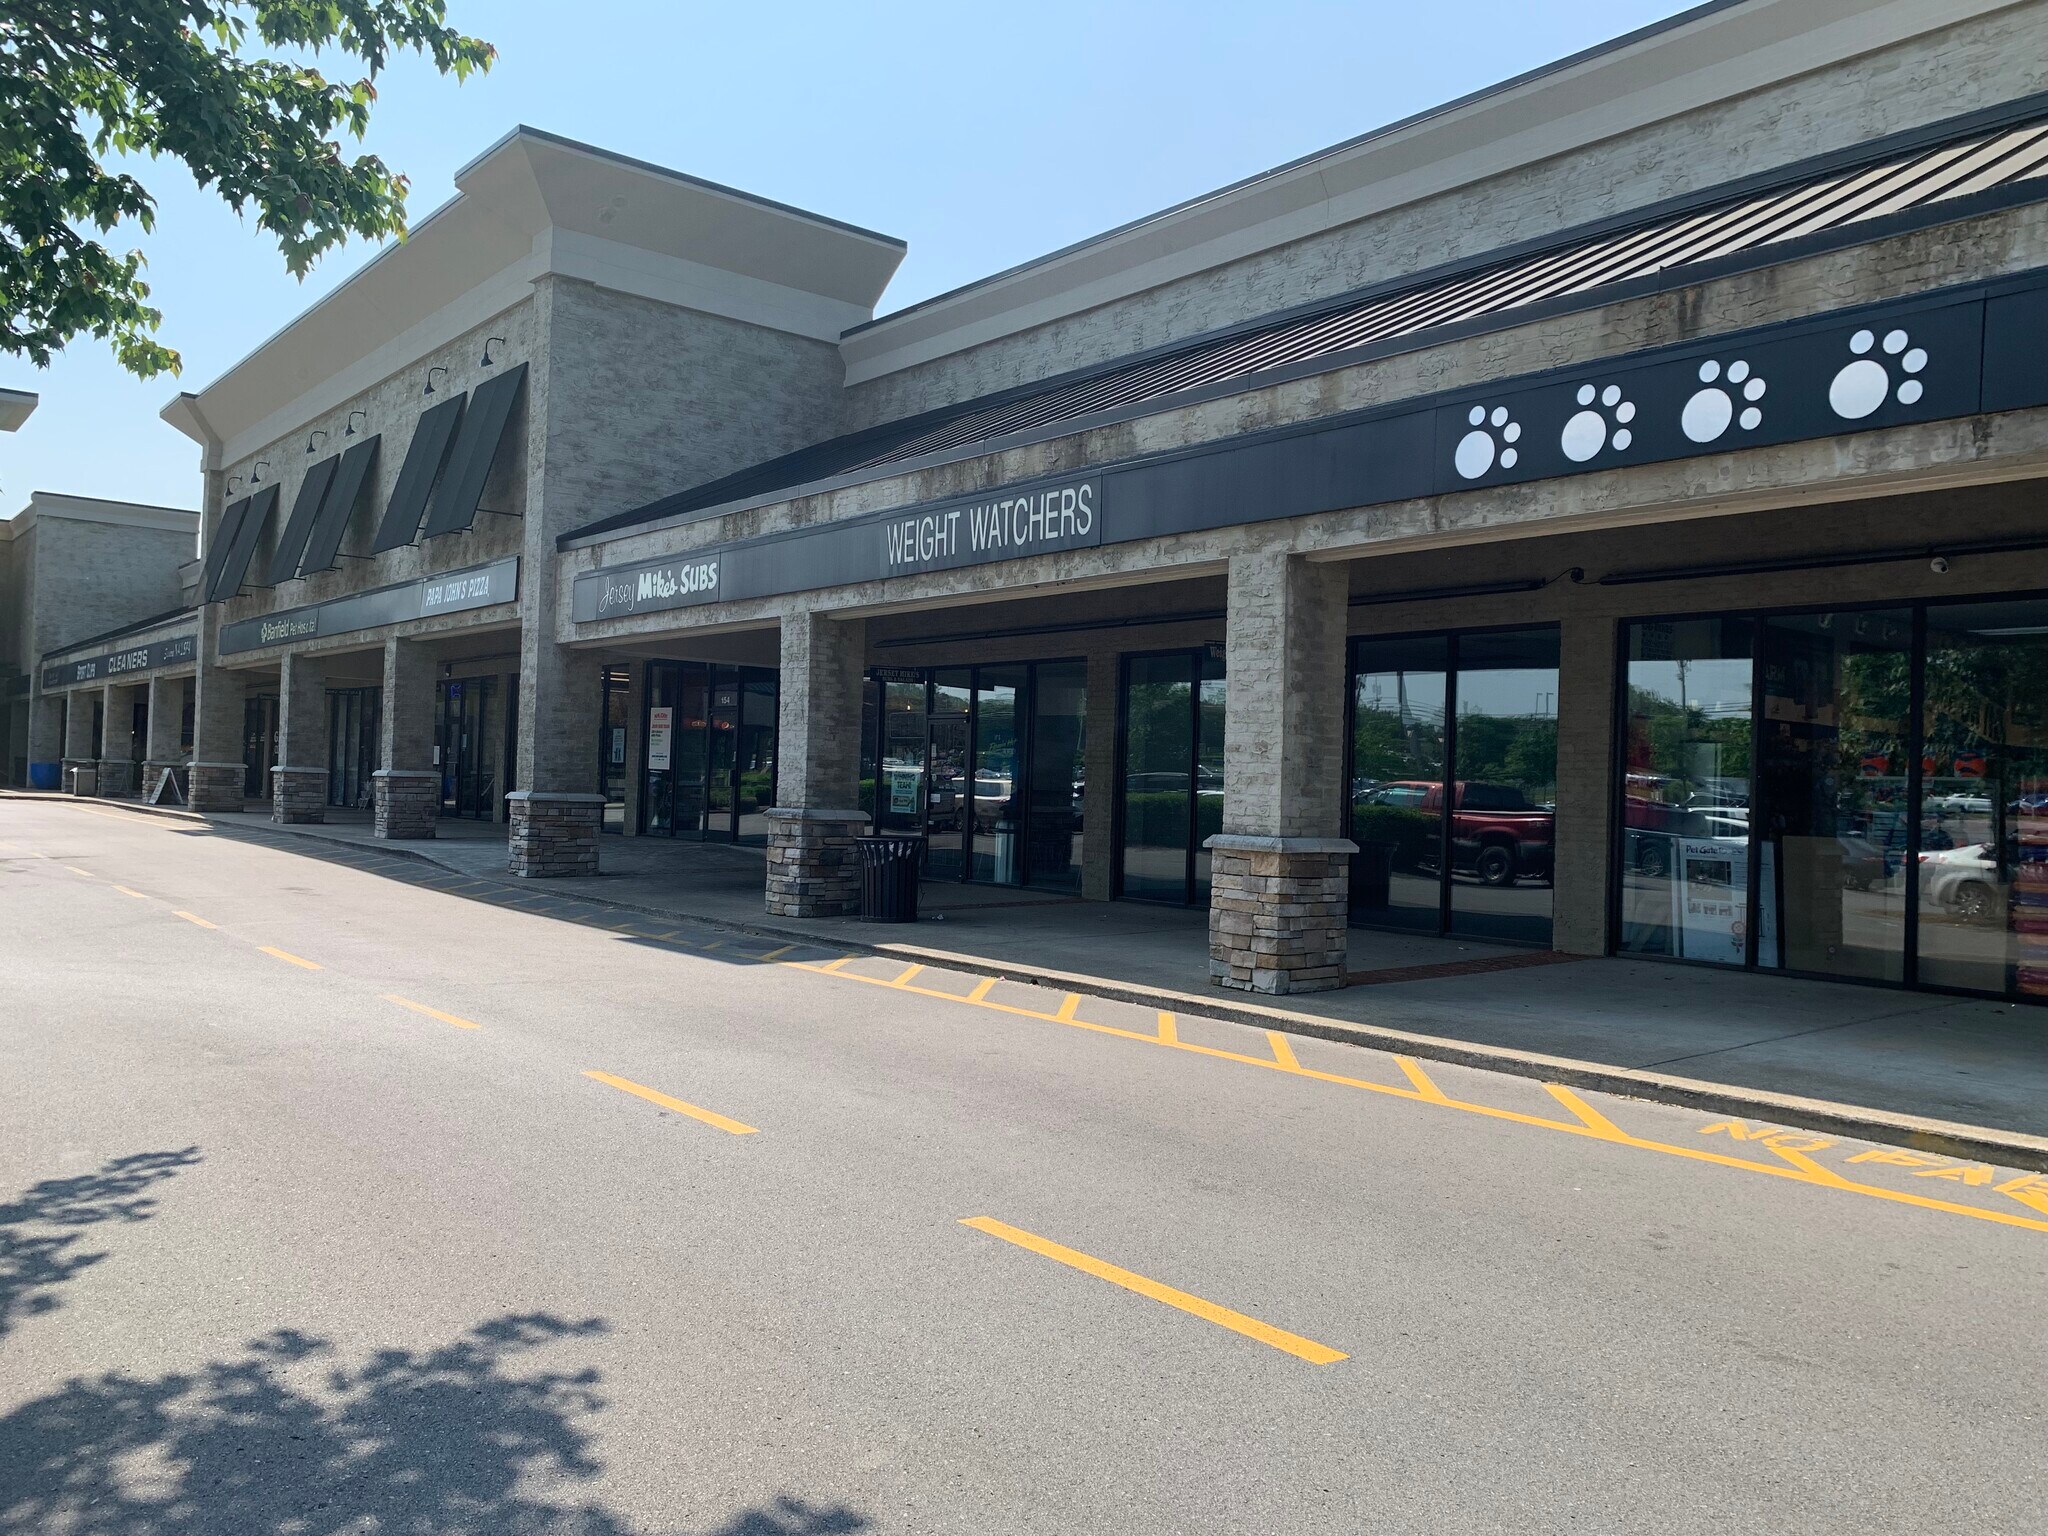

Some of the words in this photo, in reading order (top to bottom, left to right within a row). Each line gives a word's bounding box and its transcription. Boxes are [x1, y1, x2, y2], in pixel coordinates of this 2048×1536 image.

[886, 510, 961, 565] WEIGHT
[969, 483, 1093, 551] WATCHERS
[425, 586, 443, 607] PAPA
[443, 579, 468, 603] JOHN'S
[467, 575, 490, 598] PIZZA
[599, 576, 635, 613] Jersey
[637, 569, 678, 602] Mike's
[680, 562, 718, 595] SUBS
[266, 618, 290, 641] Banfield
[108, 649, 148, 674] CLEANERS
[876, 669, 898, 677] JERSEY
[1687, 845, 1698, 854] Pet
[1700, 846, 1718, 854] Gate
[1696, 1118, 1841, 1153] NO
